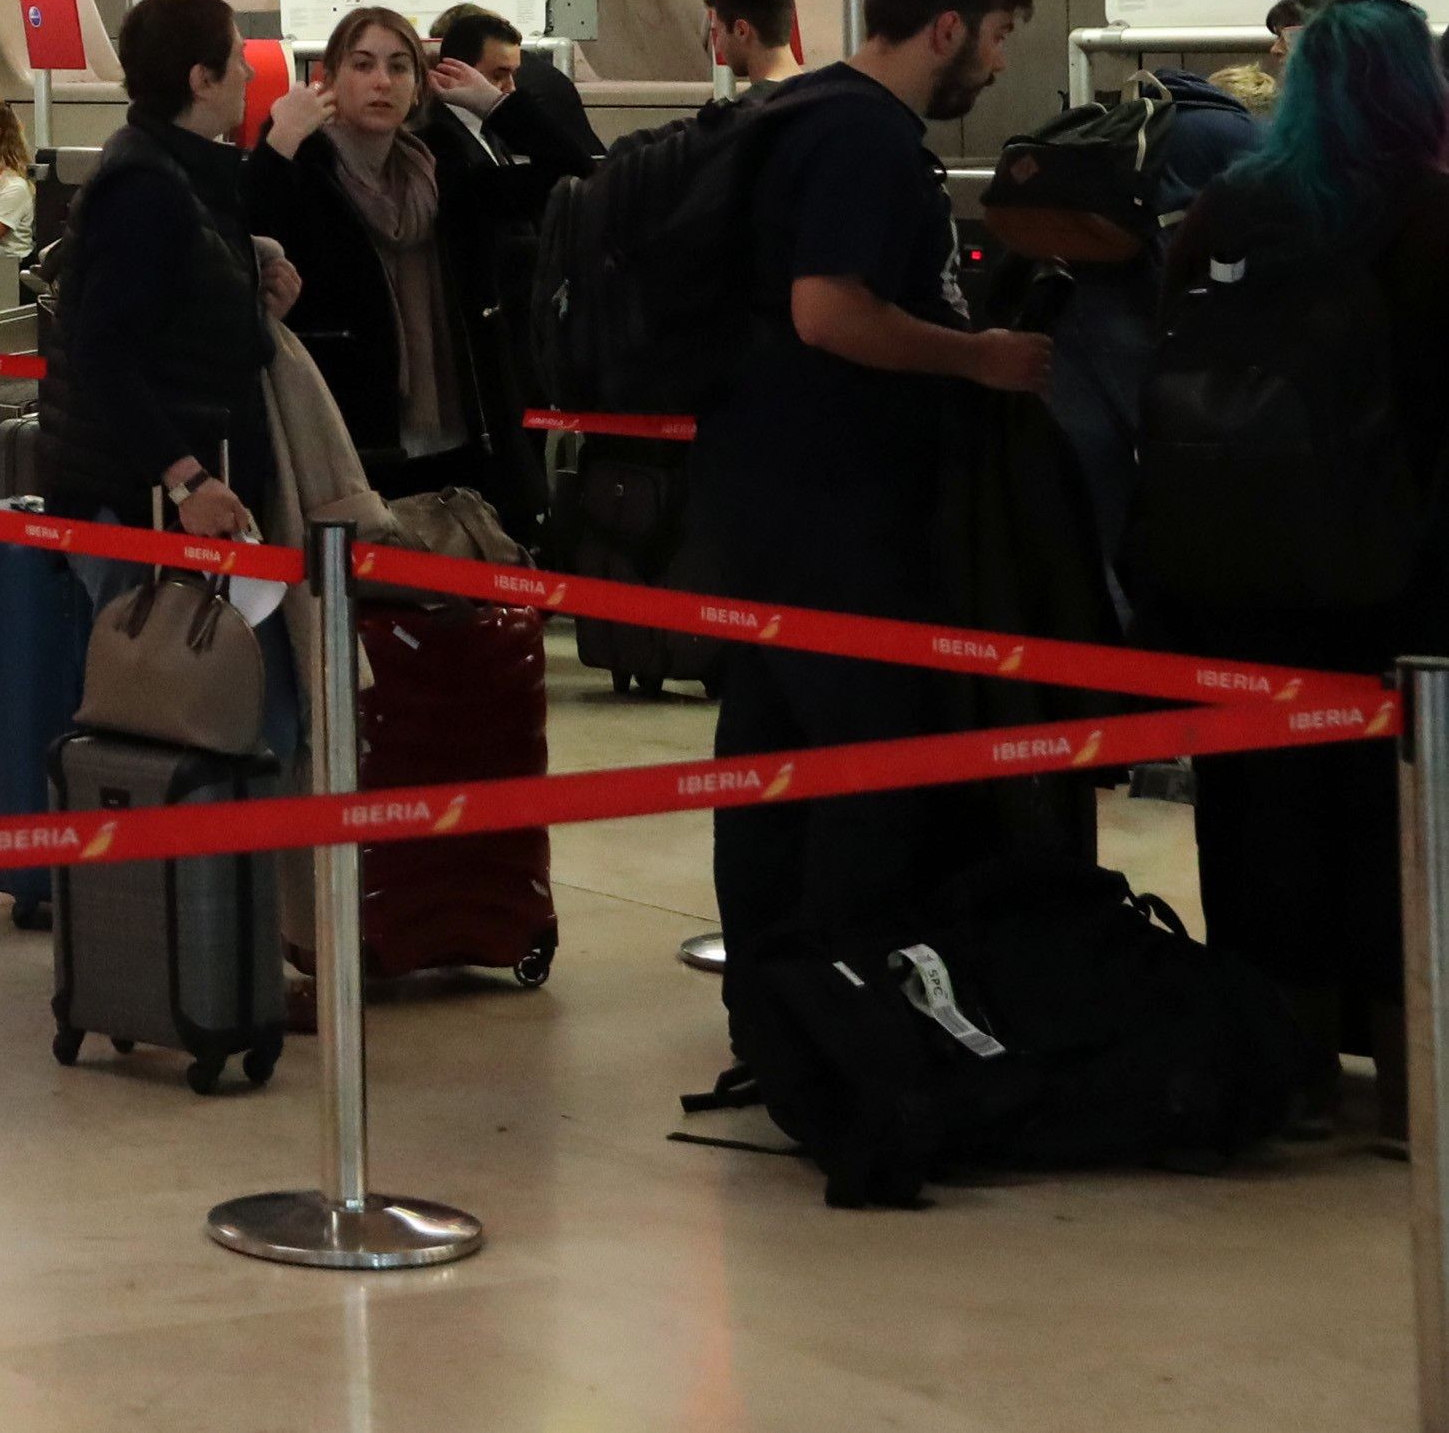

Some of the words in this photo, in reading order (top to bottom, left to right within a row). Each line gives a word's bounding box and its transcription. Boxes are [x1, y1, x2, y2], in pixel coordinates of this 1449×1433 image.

[24, 524, 60, 540] IBERIA
[183, 546, 221, 563] IBERIA
[494, 574, 546, 596] IBERIA
[700, 606, 758, 628] IBERIA
[932, 637, 999, 660] IBERIA
[1196, 669, 1271, 694] IBERIA
[1289, 706, 1365, 731] IBERIA
[992, 737, 1071, 762] IBERIA
[677, 769, 762, 796] IBERIA
[342, 800, 431, 826] IBERIA
